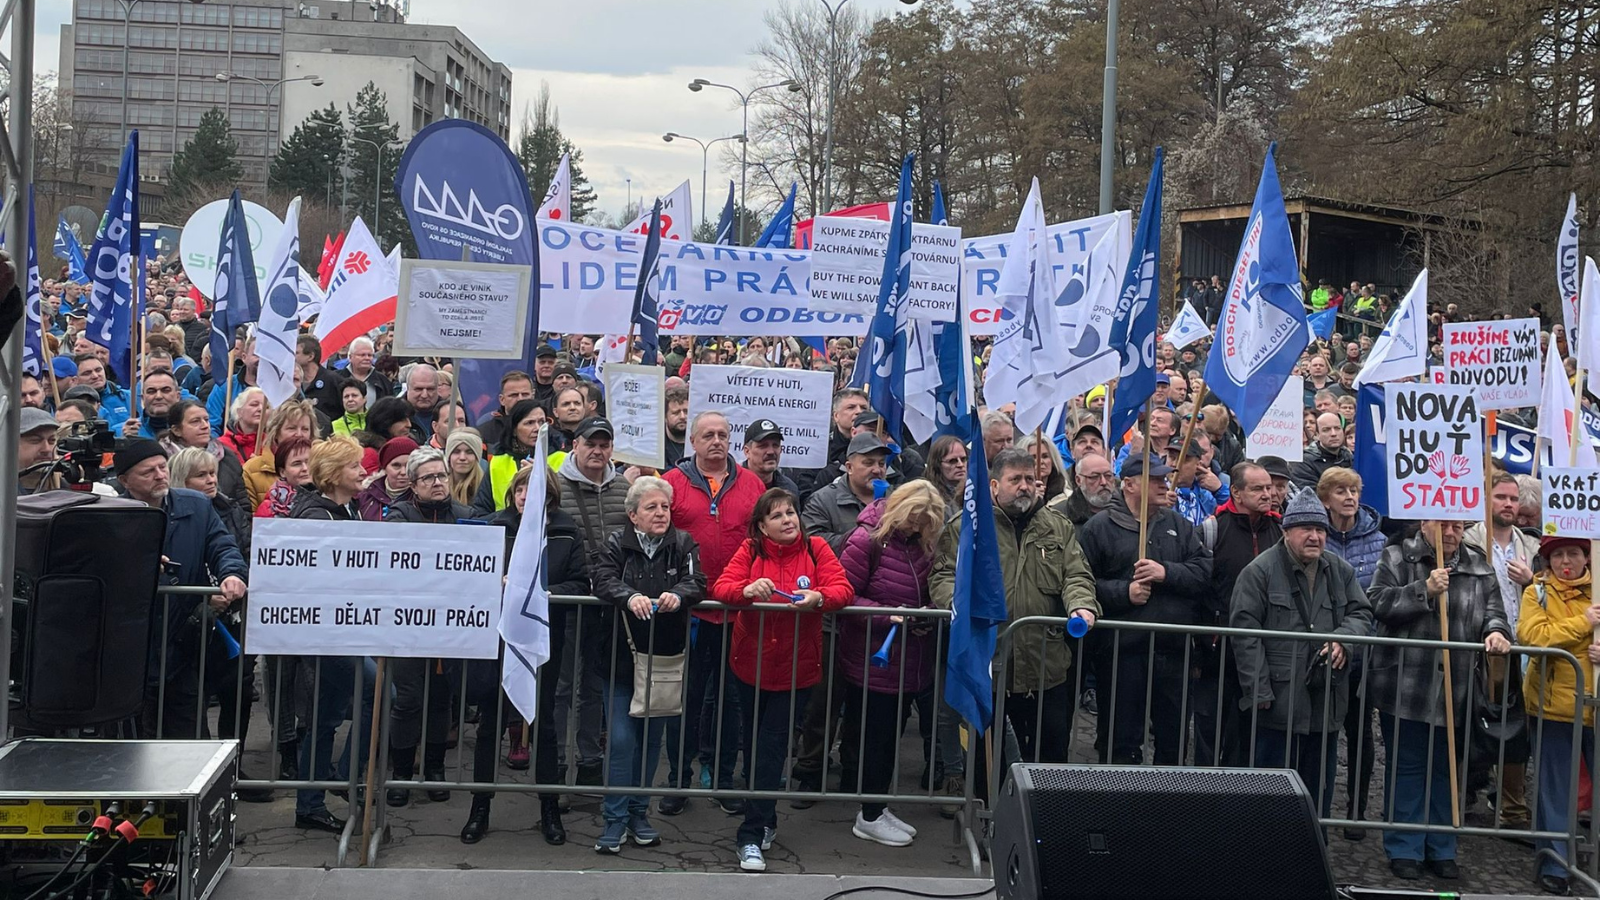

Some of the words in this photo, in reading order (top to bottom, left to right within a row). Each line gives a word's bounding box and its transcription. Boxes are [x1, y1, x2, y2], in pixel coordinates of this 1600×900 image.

[821, 226, 856, 238] KUPME
[911, 234, 956, 248] KTRÁRNU
[814, 243, 879, 258] ZACHRÁNÍME
[911, 252, 960, 265] TOVÁRNU!
[814, 272, 834, 281] BUY
[836, 273, 855, 283] THE
[858, 276, 882, 286] POW
[909, 281, 929, 290] ANT
[931, 282, 956, 293] BACK
[478, 294, 508, 302] STAVU?
[812, 290, 828, 300] WE
[830, 291, 854, 301] WILL
[909, 298, 956, 310] FACTORY!
[1226, 303, 1238, 357] BOSCH
[1232, 251, 1250, 301] DIESEL
[440, 328, 482, 338] NEJSME!
[1450, 326, 1509, 346] ZRUŠÍME
[1514, 324, 1537, 346] VÁM
[1450, 347, 1490, 368] PRÁCI
[727, 374, 764, 387] VÍTEJTE
[768, 378, 774, 387] V
[777, 380, 804, 392] HUTI,
[1450, 365, 1528, 386] DŮVODU!
[708, 393, 742, 405] KTERÁ
[744, 395, 776, 407] NEMÁ
[778, 399, 817, 410] ENERGII
[1480, 388, 1501, 400] VAŠE
[1504, 387, 1528, 399] VLÁDA
[1397, 387, 1477, 422] NOVÁ
[796, 428, 820, 440] MILL,
[1399, 423, 1471, 456] HUŤ
[1395, 452, 1430, 480] DO
[1548, 472, 1600, 492] VRAŤ
[1402, 478, 1479, 510] STÁTU
[257, 548, 318, 568] NEJSME
[332, 550, 342, 567] V
[346, 550, 379, 568] HUTI
[390, 552, 421, 570] PRO
[436, 552, 496, 574] LEGRACI
[260, 606, 321, 625] CHCEME
[335, 602, 382, 626] DĚLAT
[394, 608, 436, 627] SVOJI
[446, 605, 490, 628] PRÁCI
